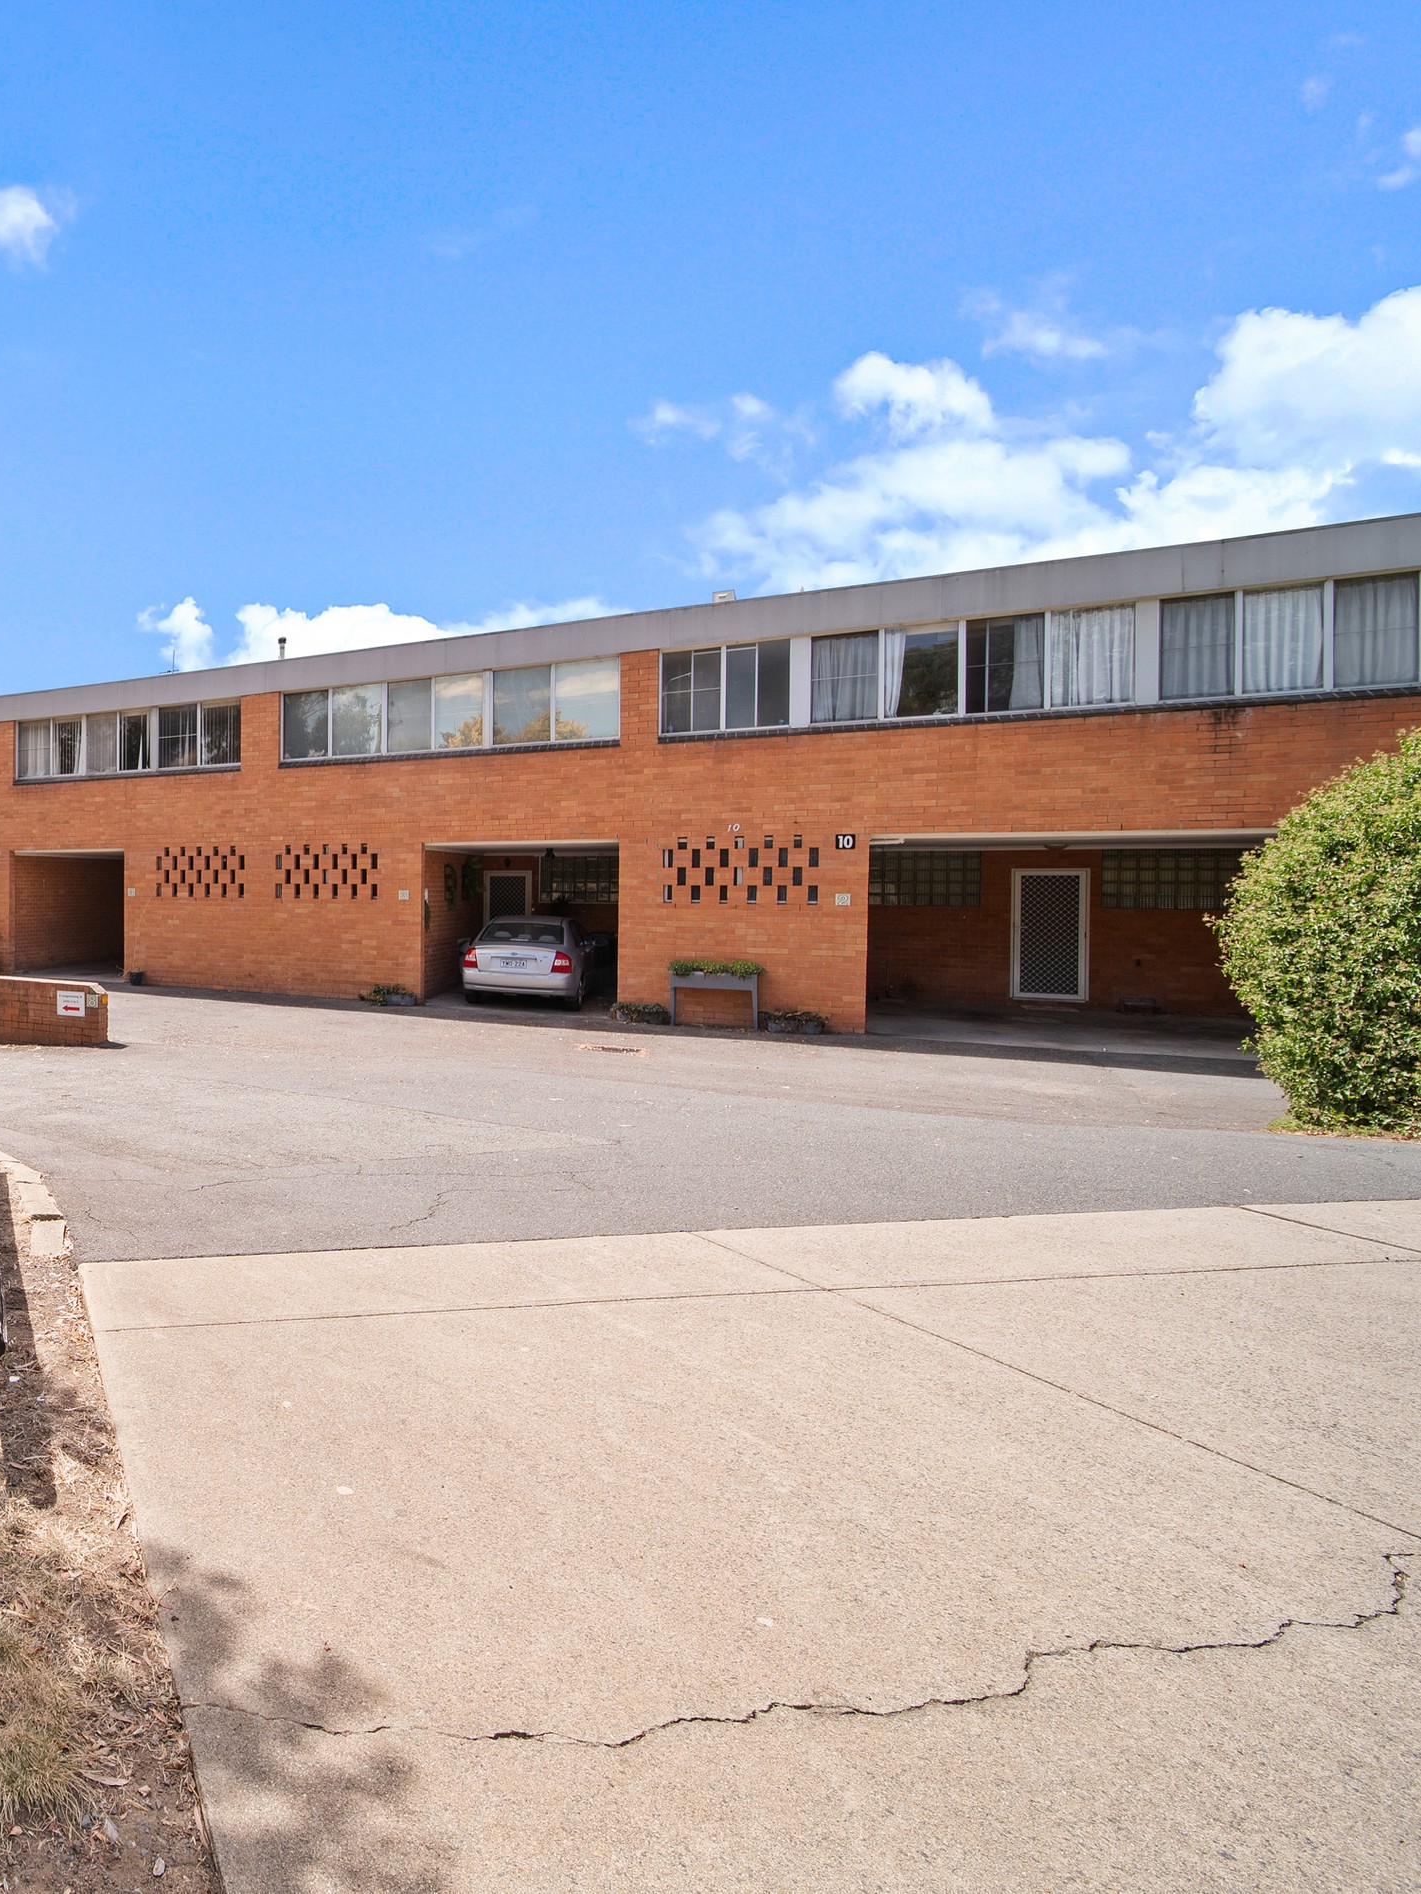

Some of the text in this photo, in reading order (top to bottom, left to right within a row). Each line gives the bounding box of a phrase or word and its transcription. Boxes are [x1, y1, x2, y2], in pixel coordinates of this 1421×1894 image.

[727, 823, 740, 832] 10
[837, 835, 854, 849] 10
[837, 893, 850, 905] 2
[88, 994, 96, 1007] 8
